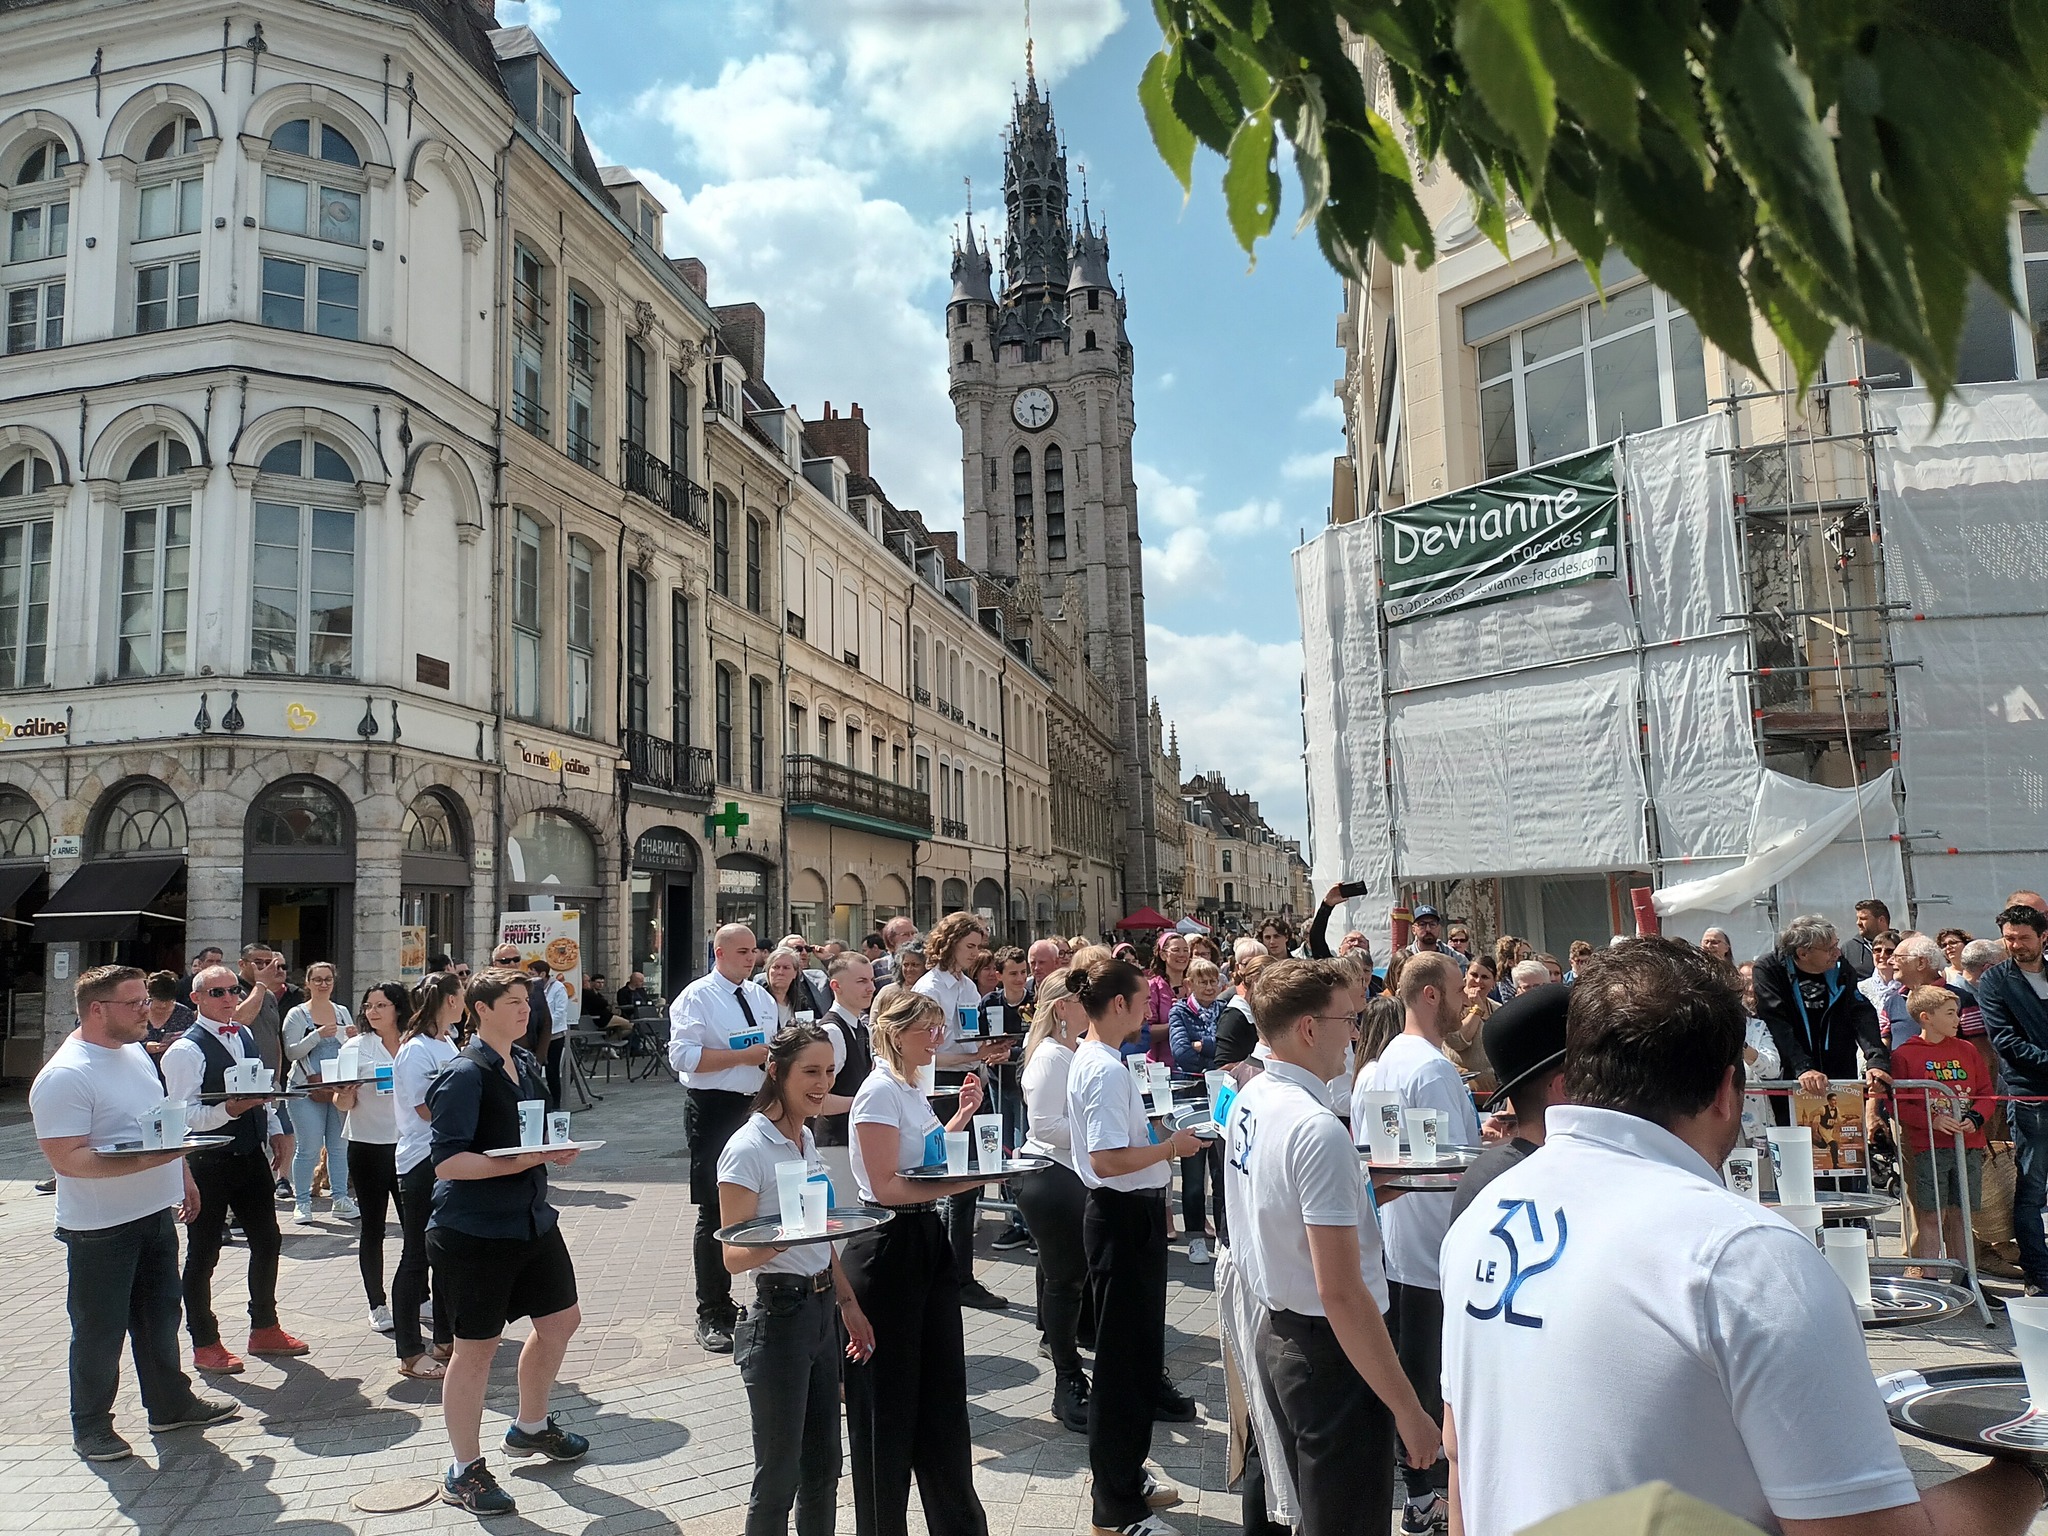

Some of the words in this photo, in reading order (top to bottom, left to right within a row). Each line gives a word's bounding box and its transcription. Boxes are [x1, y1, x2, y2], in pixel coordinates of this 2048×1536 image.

[1394, 487, 1581, 565] Devianne
[1474, 553, 1608, 597] devianne-facades.com
[14, 717, 67, 738] câline
[522, 748, 532, 763] la
[533, 751, 550, 767] mie
[565, 758, 590, 776] câline
[641, 837, 687, 858] PHARMACIE
[504, 923, 527, 933] PORTE
[528, 923, 541, 932] SES
[504, 932, 540, 945] FRUITS
[1924, 1068, 1968, 1080] MARIO
[1925, 1059, 1961, 1070] SUPER
[1475, 1258, 1497, 1284] LE
